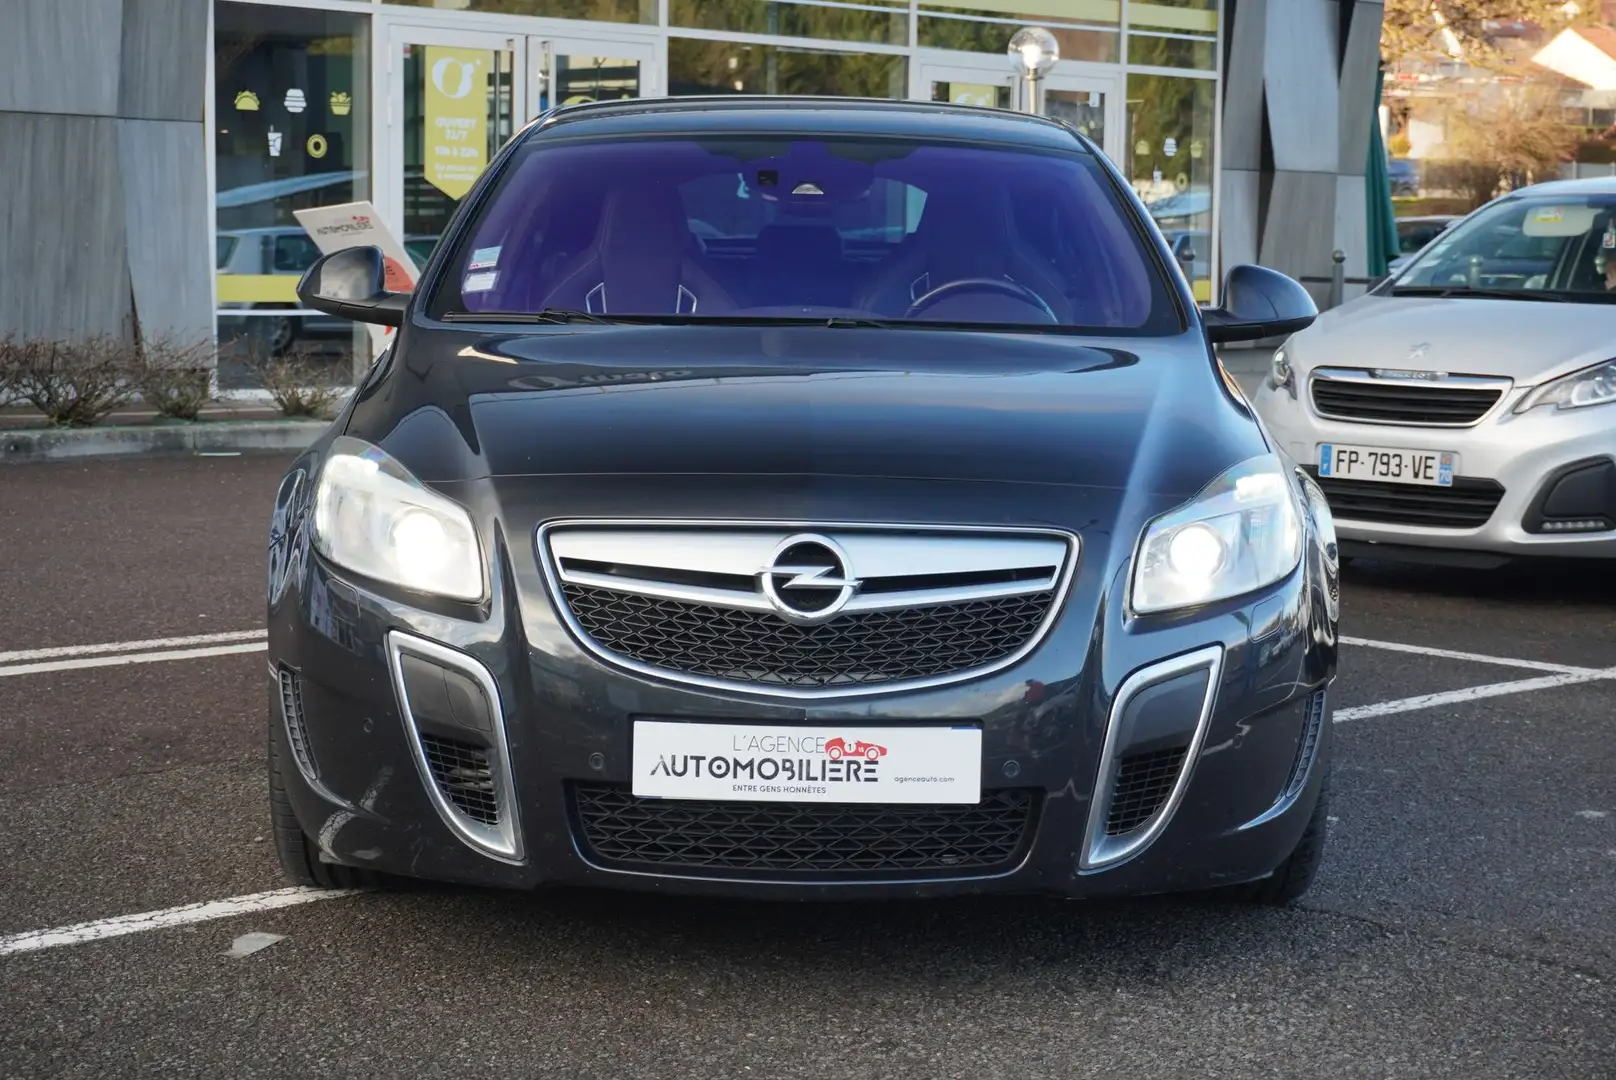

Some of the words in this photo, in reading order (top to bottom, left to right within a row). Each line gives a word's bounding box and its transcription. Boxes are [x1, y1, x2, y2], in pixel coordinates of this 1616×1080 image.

[1336, 450, 1435, 480] FP-793-VE
[733, 735, 825, 753] L'AGENCE
[733, 784, 757, 792] ENTRE
[759, 785, 781, 793] GENS
[783, 785, 826, 794] HONNÊTES
